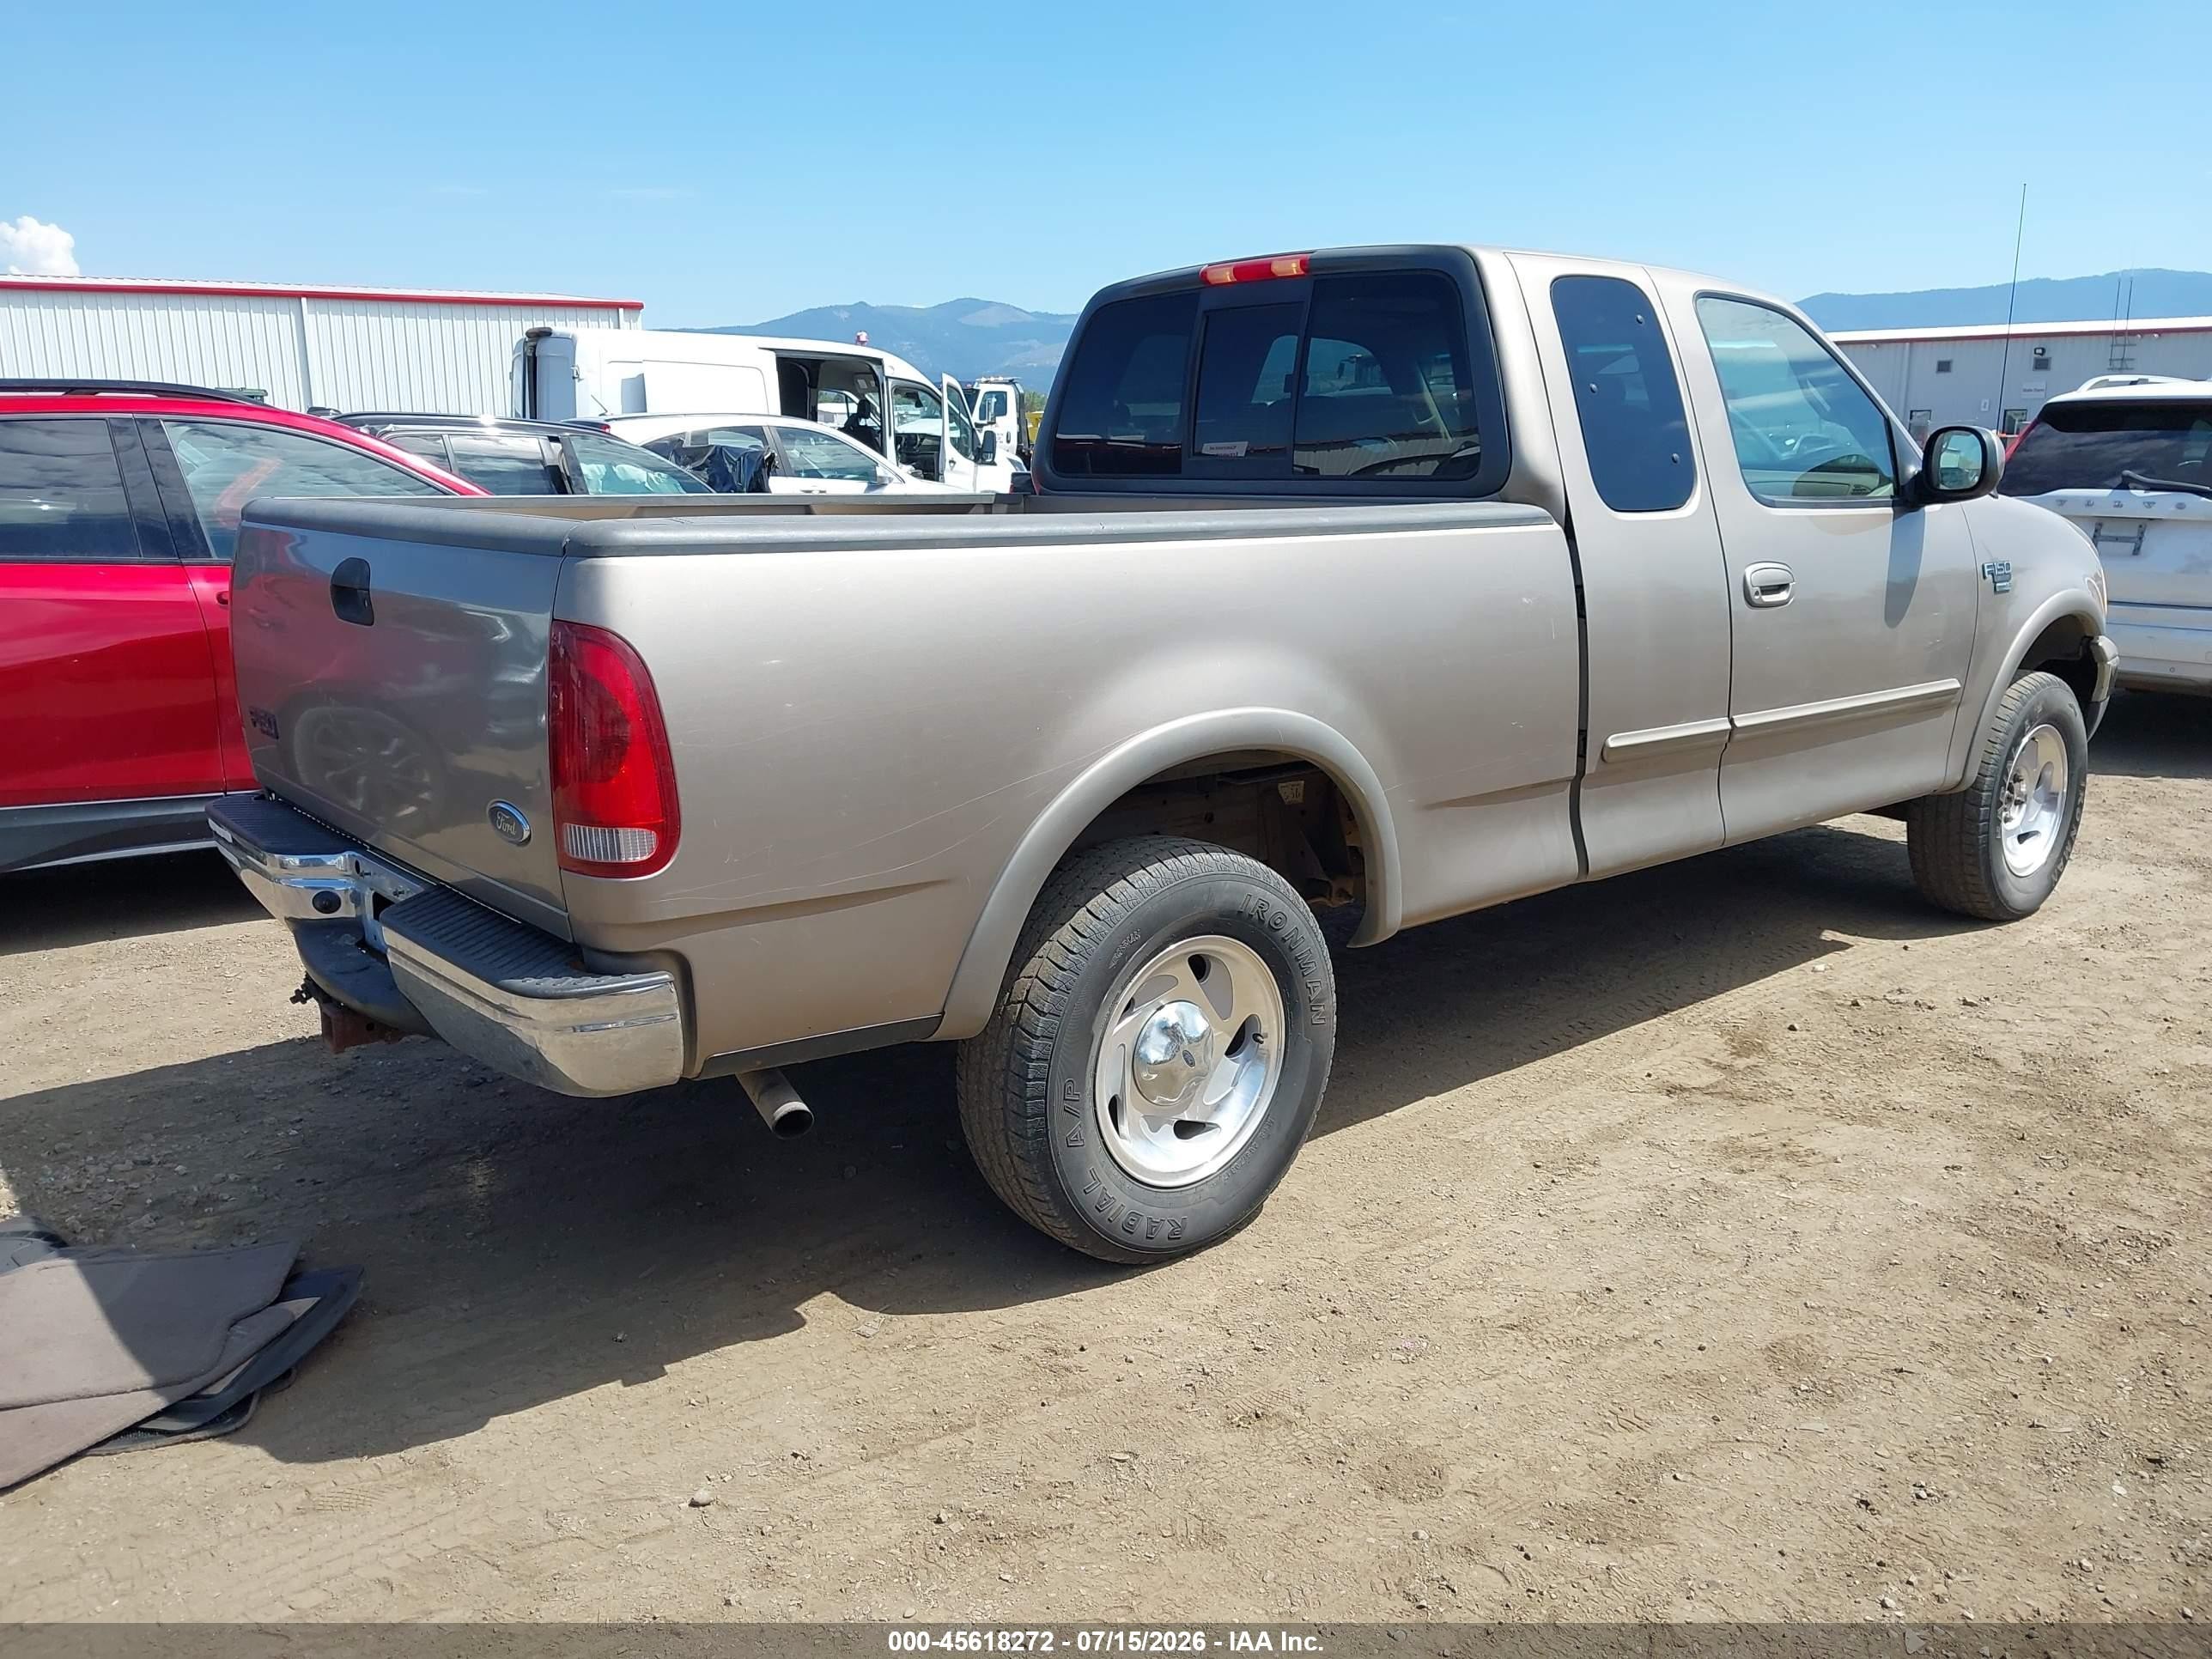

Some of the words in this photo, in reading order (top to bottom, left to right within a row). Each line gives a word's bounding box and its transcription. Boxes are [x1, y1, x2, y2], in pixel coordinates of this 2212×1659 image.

[1238, 892, 1327, 1026] IRONMAN
[1065, 1078, 1086, 1149] A/P
[1082, 1166, 1188, 1242] RADIAL
